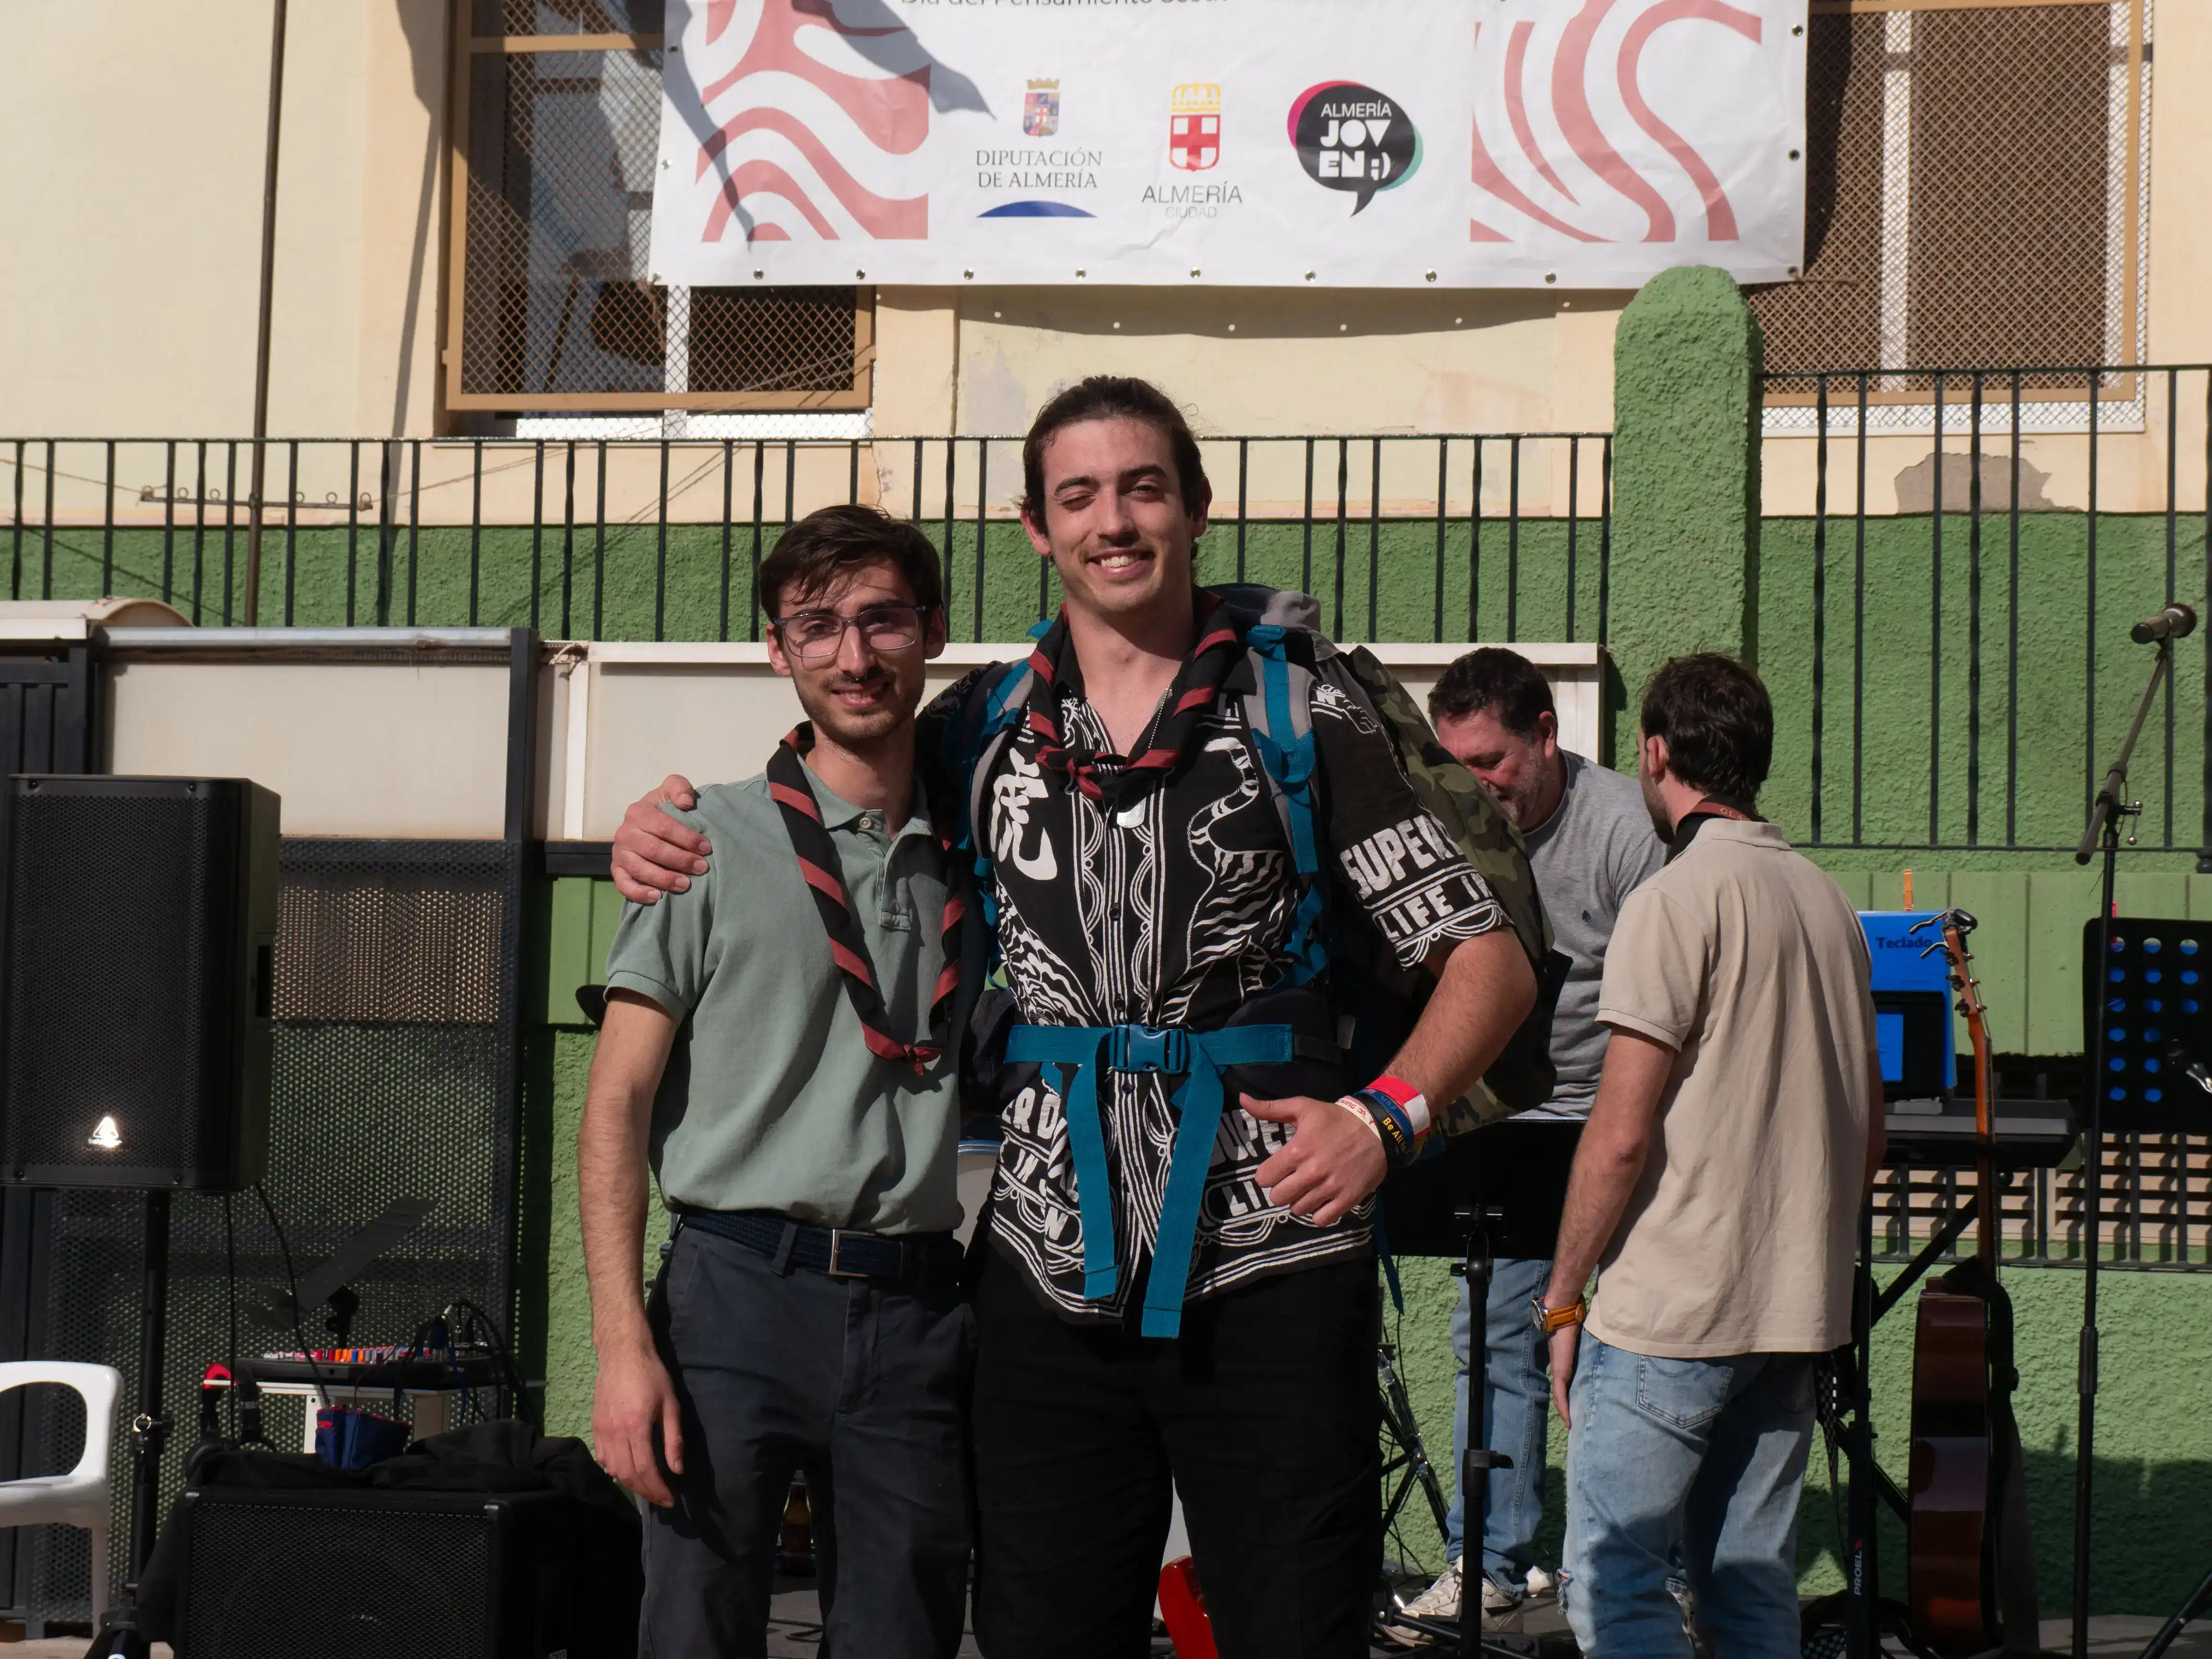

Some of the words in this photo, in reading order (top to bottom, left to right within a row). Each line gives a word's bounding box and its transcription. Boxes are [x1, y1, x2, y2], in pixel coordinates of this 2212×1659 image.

[1321, 99, 1392, 117] ALMERÍA
[1320, 120, 1391, 147] JOV
[976, 147, 1103, 167] DIPUTACIÓN
[978, 171, 1002, 188] DE
[1009, 168, 1097, 188] ALMERÍA
[1142, 180, 1242, 203] ALMERÍA
[1166, 206, 1217, 218] CIUDAD
[1379, 885, 1454, 939] LIFE
[1875, 936, 1933, 949] Teclado
[1383, 1117, 1394, 1130] Be
[1392, 1130, 1404, 1143] All
[1854, 1551, 1862, 1596] PROEL
